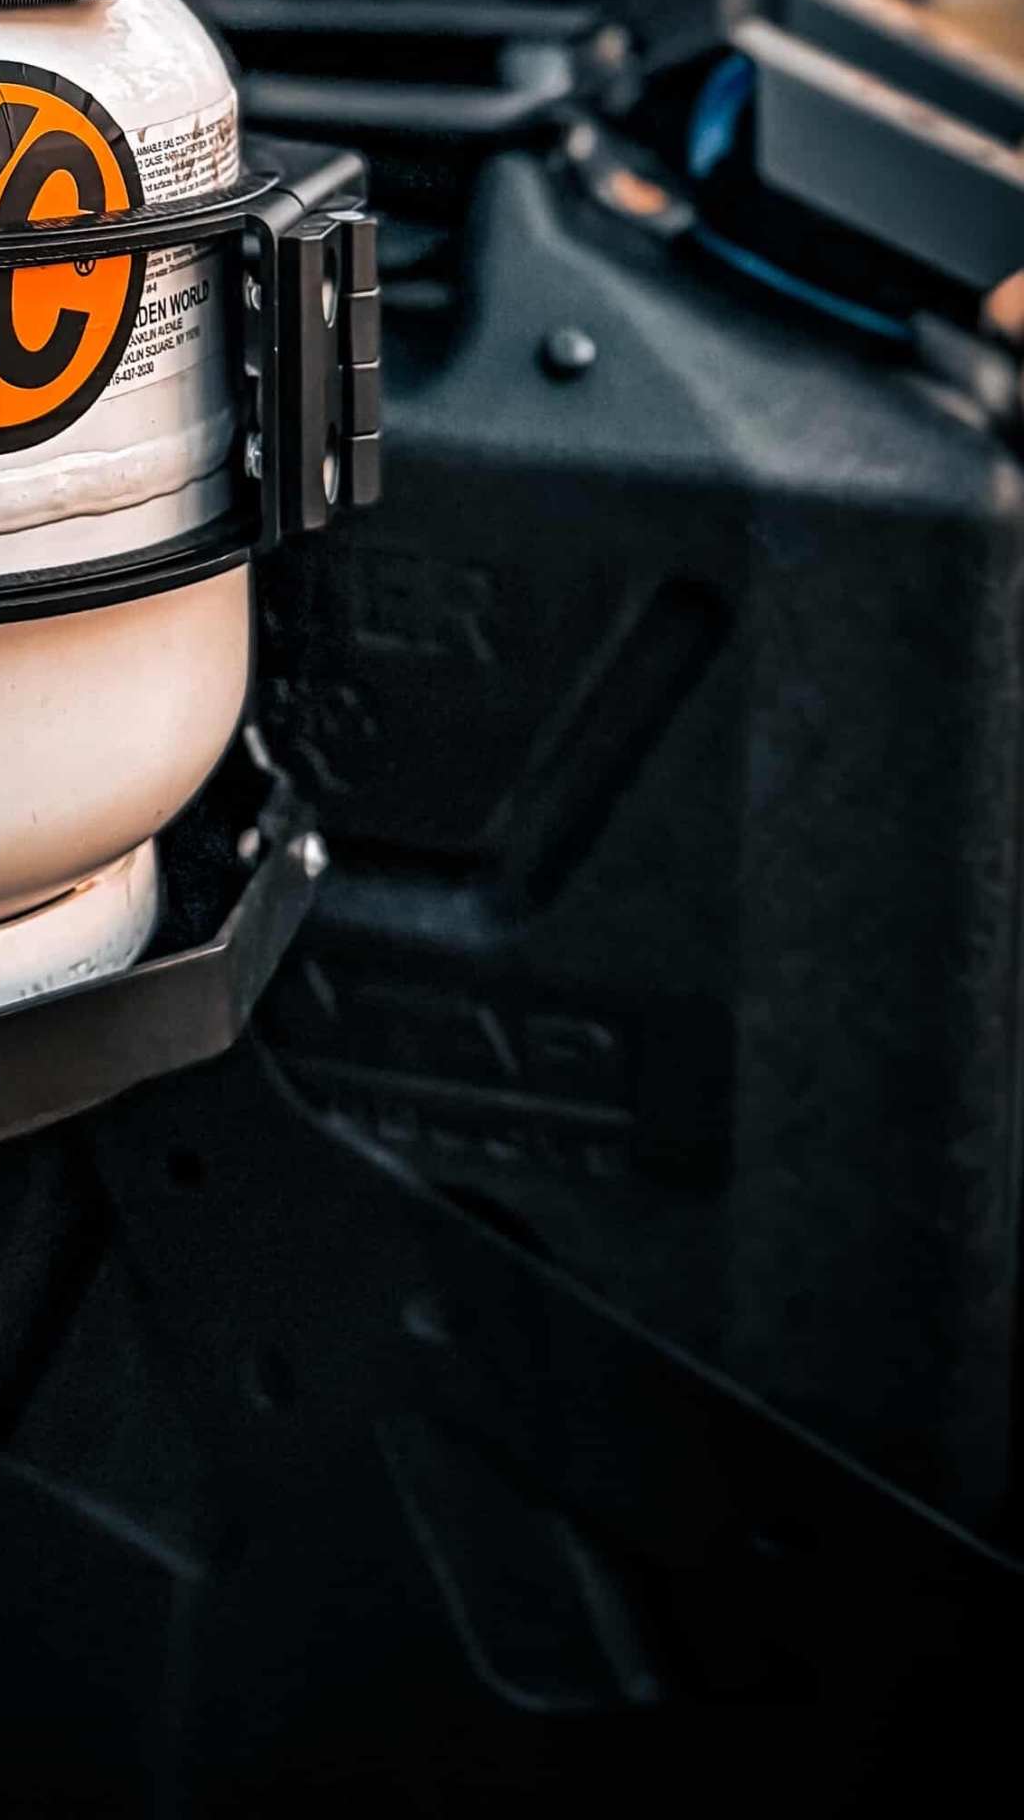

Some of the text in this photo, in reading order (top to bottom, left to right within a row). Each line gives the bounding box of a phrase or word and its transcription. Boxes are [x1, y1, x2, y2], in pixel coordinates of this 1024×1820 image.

[135, 280, 209, 328] DEN WORLD
[130, 329, 157, 348] ANKLIN
[157, 317, 183, 336] AVENUE
